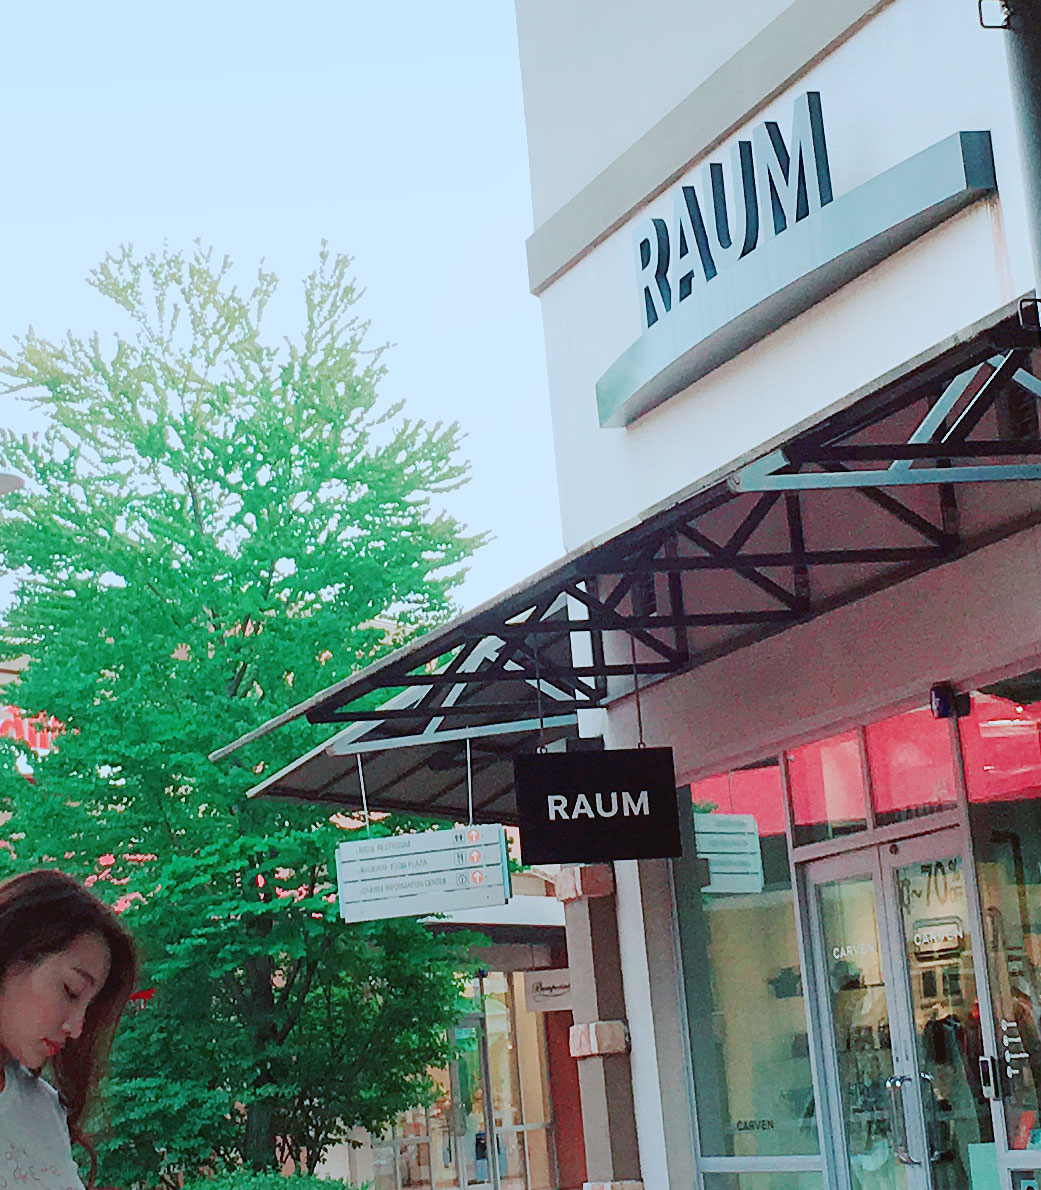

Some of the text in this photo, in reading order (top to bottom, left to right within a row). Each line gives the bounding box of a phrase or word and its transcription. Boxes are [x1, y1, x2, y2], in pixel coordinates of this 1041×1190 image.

[633, 91, 834, 333] RAUM
[547, 790, 650, 821] RAUM
[832, 943, 875, 960] CARVEN
[736, 1119, 774, 1131] CARVEN
